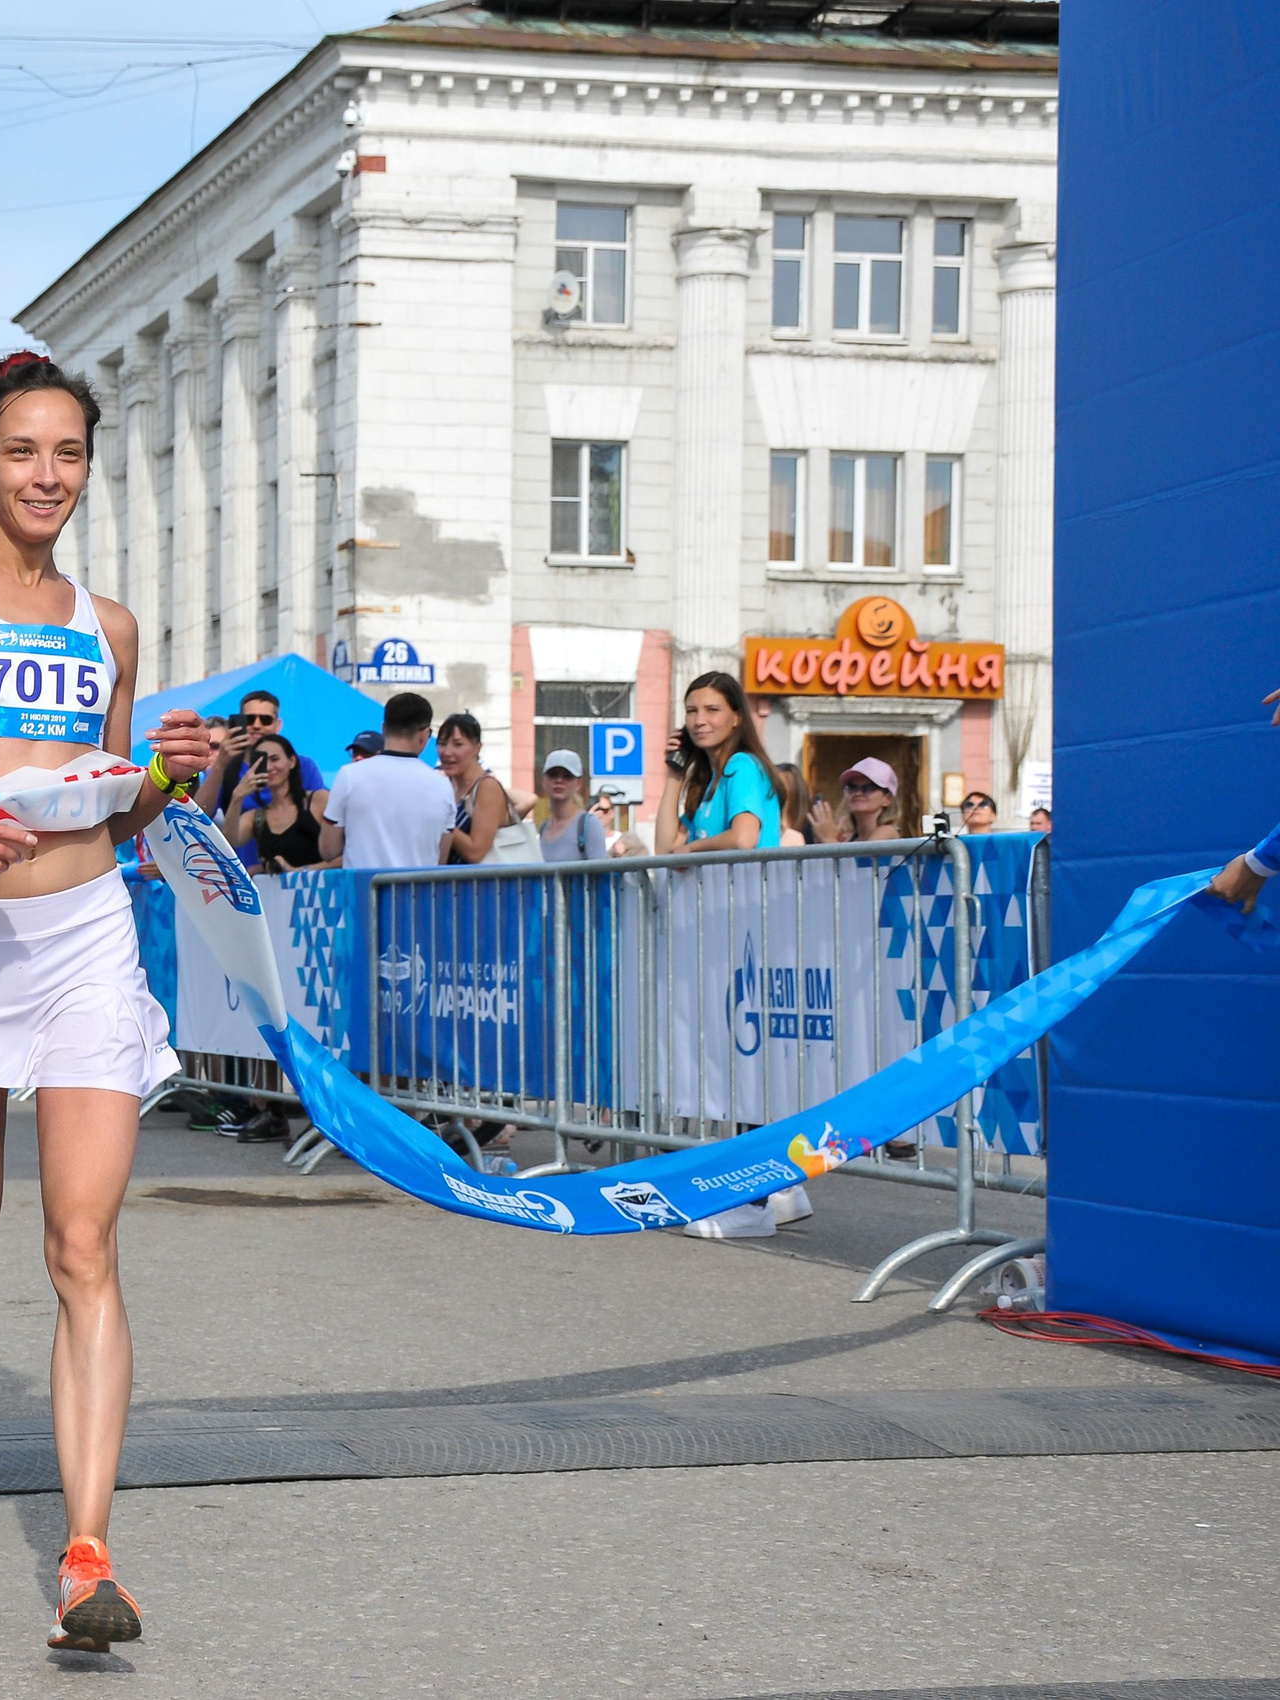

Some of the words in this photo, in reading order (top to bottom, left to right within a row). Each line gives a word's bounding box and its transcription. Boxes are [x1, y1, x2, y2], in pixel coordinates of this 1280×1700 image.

[19, 639, 66, 650] МАРАФОН
[383, 642, 409, 664] 26
[359, 666, 381, 683] ул.
[381, 665, 432, 682] ЛЕНИНА
[756, 638, 1002, 694] кофейня
[19, 722, 45, 736] 42,2
[47, 724, 66, 736] КМ
[30, 713, 50, 722] ИЮЛЯ
[51, 714, 66, 723] 2019
[605, 727, 635, 772] P
[691, 1158, 785, 1192] Running
[728, 1165, 798, 1193] Russia
